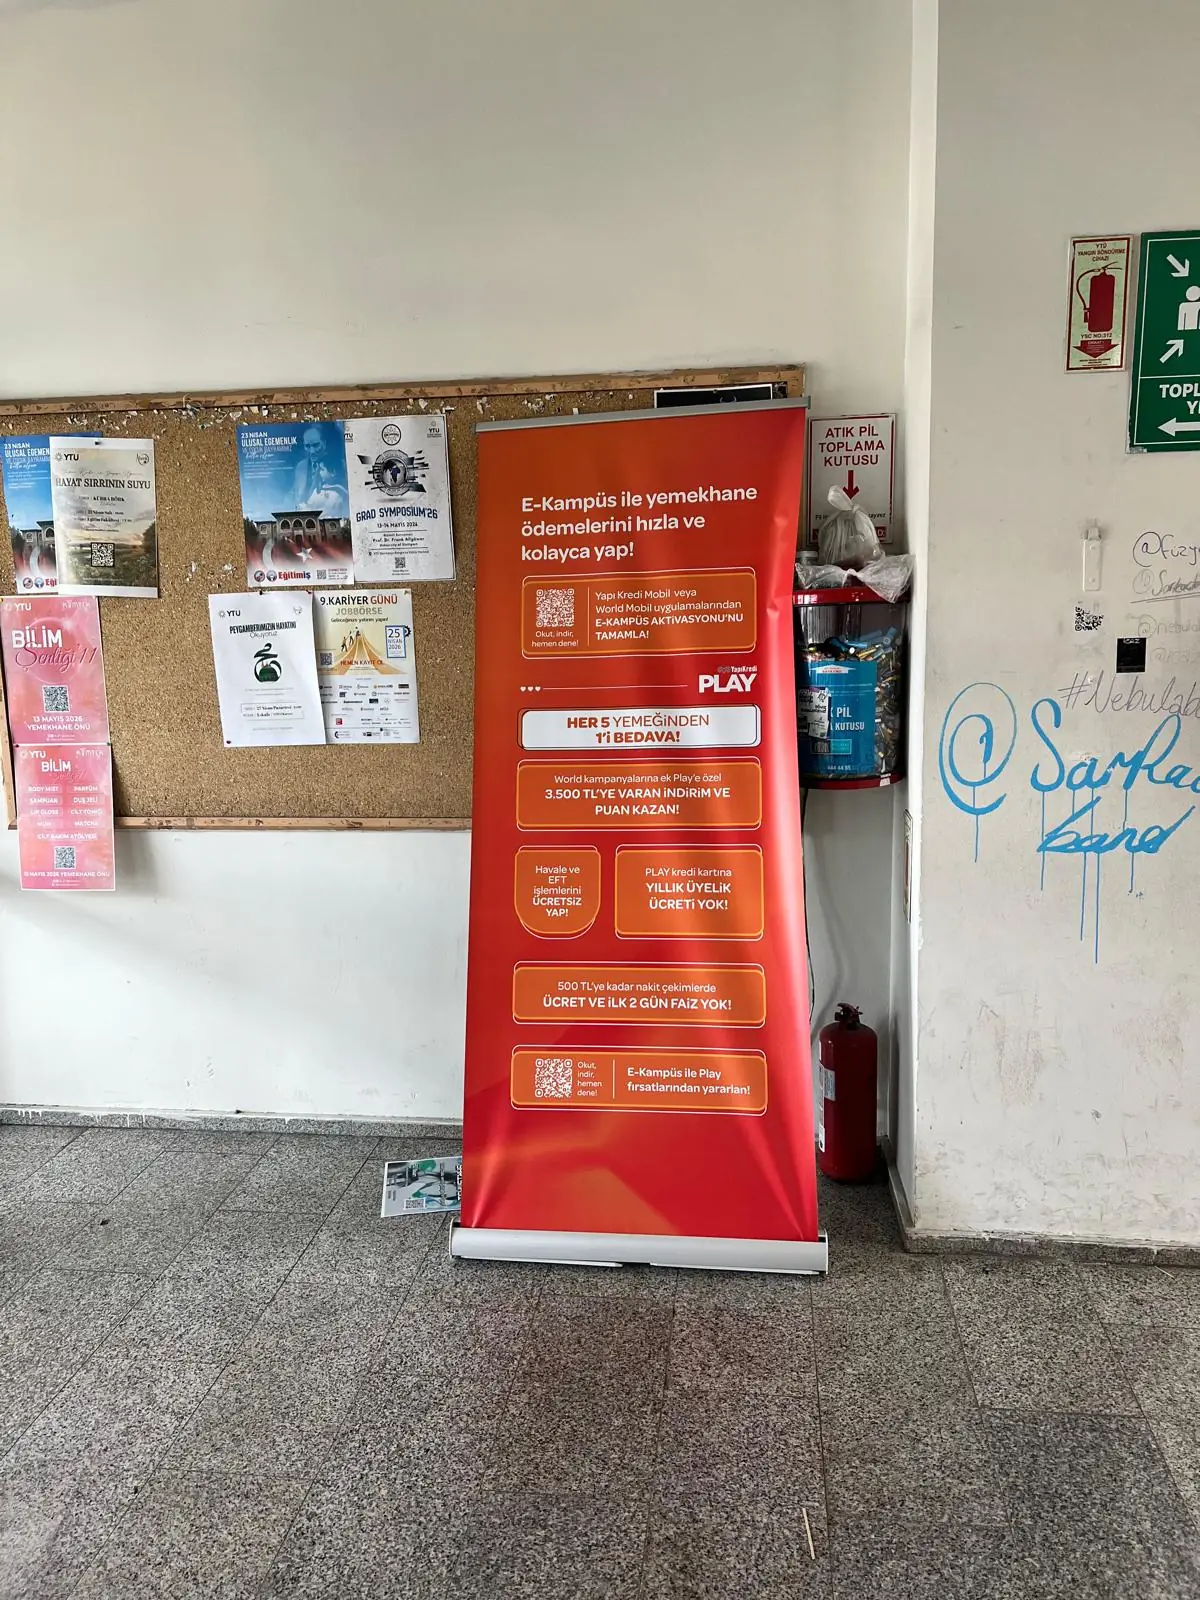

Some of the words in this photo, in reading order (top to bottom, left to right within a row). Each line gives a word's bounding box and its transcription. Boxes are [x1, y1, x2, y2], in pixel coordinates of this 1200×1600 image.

[825, 426, 854, 438] ATIK
[859, 424, 878, 437] PİL
[241, 438, 263, 447] ULUSAL
[818, 439, 885, 453] TOPLAMA
[4, 449, 26, 458] ULUSAL
[63, 453, 79, 462] YTU
[824, 454, 878, 467] KUTUSU
[56, 477, 83, 487] HAYAT
[84, 479, 125, 489] SIRRININ
[127, 480, 151, 489] SUYU
[521, 493, 617, 512] E-Kampüs
[621, 491, 642, 507] ile
[646, 487, 758, 508] yemekhane
[356, 509, 376, 522] GRAD
[521, 517, 632, 536] ödemelerini
[637, 515, 679, 531] hızla
[683, 517, 705, 529] ve
[521, 545, 590, 563] kolayca
[594, 542, 634, 561] yap!
[370, 593, 398, 605] GÜNÜ
[595, 592, 616, 601] Yapı
[617, 589, 643, 599] Kredi
[644, 589, 671, 598] Mobil
[674, 590, 697, 600] veya
[15, 603, 31, 611] YTU
[335, 605, 383, 616] JOBBÖRSE
[595, 604, 625, 614] World
[626, 603, 653, 612] Mobil
[654, 599, 742, 613] uygulamalarından
[595, 615, 649, 627] E-KAMPÜS
[11, 625, 63, 648] BİLİM
[388, 628, 400, 638] 25
[595, 630, 649, 640] TAMAMLA!
[531, 639, 557, 648] hemen
[699, 674, 757, 693] PLAY
[836, 704, 852, 718] PİL
[42, 715, 64, 723] MAYIS
[567, 717, 598, 728] HER
[601, 716, 610, 728] 5
[835, 722, 864, 731] KUTUSU
[614, 731, 680, 743] BEDAVA!
[30, 750, 46, 758] YTU
[41, 759, 71, 772] BİLİM
[554, 774, 582, 783] World
[584, 773, 659, 785] kampanyalarına
[660, 773, 672, 782] ek
[673, 773, 701, 784] Play'e
[703, 773, 722, 782] özel
[545, 788, 580, 799] 3.500
[583, 787, 615, 799] TL'YE
[618, 787, 661, 798] VARAN
[713, 787, 730, 797] VE
[595, 804, 630, 815] PUAN
[632, 803, 680, 815] KAZAN!
[535, 865, 567, 874] Havale
[568, 866, 580, 875] ve
[645, 867, 670, 877] PLAY
[671, 867, 696, 877] kredi
[697, 867, 732, 877] kartına
[548, 876, 565, 885] EFT
[533, 885, 582, 898] işlemlerini
[646, 882, 684, 893] YILLIK
[697, 899, 729, 909] YOK!
[545, 908, 569, 917] YAP!
[558, 982, 578, 991] 500
[580, 982, 605, 993] TL'ye
[606, 982, 635, 992] kadar
[636, 982, 661, 992] nakit
[662, 983, 716, 995] çekimlerde
[543, 994, 586, 1007] ÜCRET
[588, 997, 605, 1007] VE
[629, 998, 637, 1008] 2
[640, 996, 668, 1008] GÜN
[701, 999, 732, 1010] YOK!
[577, 1061, 596, 1070] Okut,
[577, 1071, 595, 1080] indir,
[627, 1067, 683, 1081] E-Kampüs
[684, 1068, 697, 1078] ile
[699, 1069, 722, 1082] Play
[577, 1080, 602, 1089] hemen
[627, 1082, 700, 1094] fırsatlarından
[702, 1083, 751, 1097] yararlan!
[577, 1089, 598, 1098] dene!
